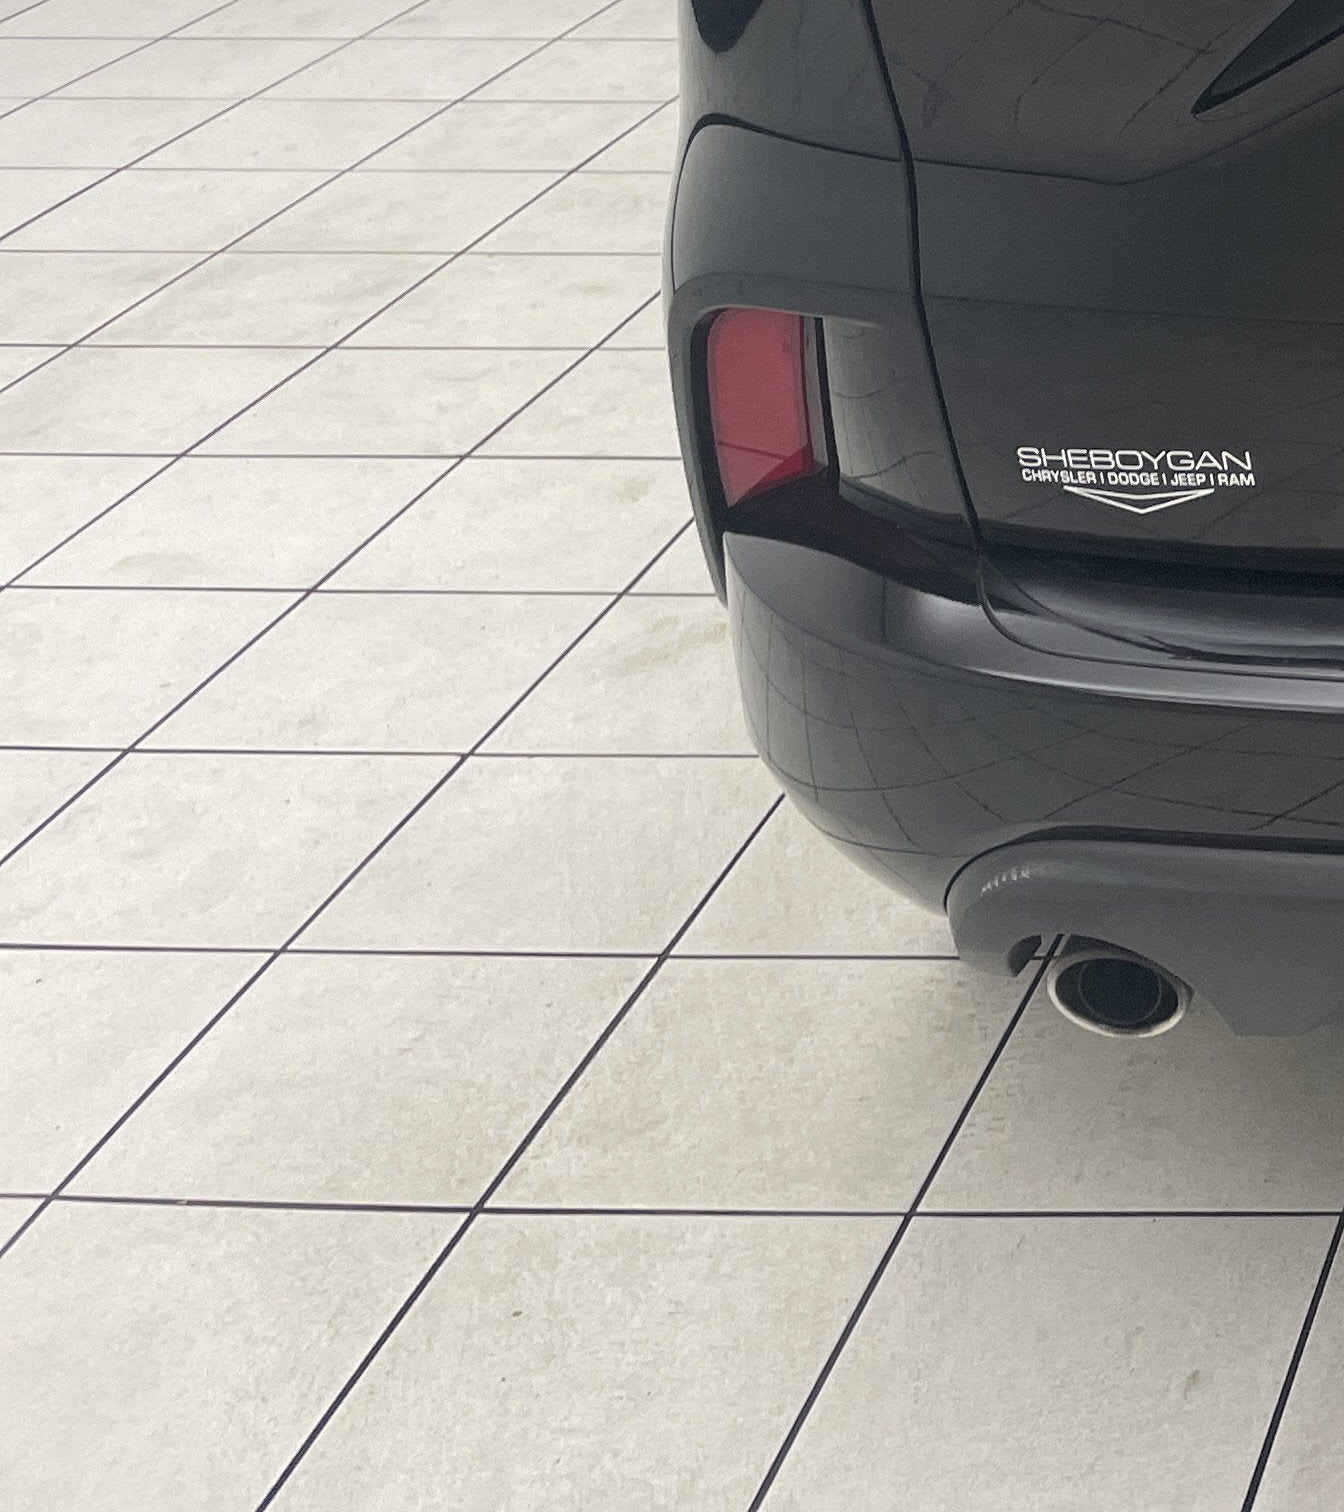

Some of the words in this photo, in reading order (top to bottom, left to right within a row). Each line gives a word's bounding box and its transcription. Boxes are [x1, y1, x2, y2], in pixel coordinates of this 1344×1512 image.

[1016, 446, 1252, 471] SHEBOYGAN
[1021, 468, 1097, 485] CHRYSLER
[1107, 471, 1160, 486] DODGE
[1170, 472, 1206, 487] JEEP
[1218, 472, 1256, 487] RAM
